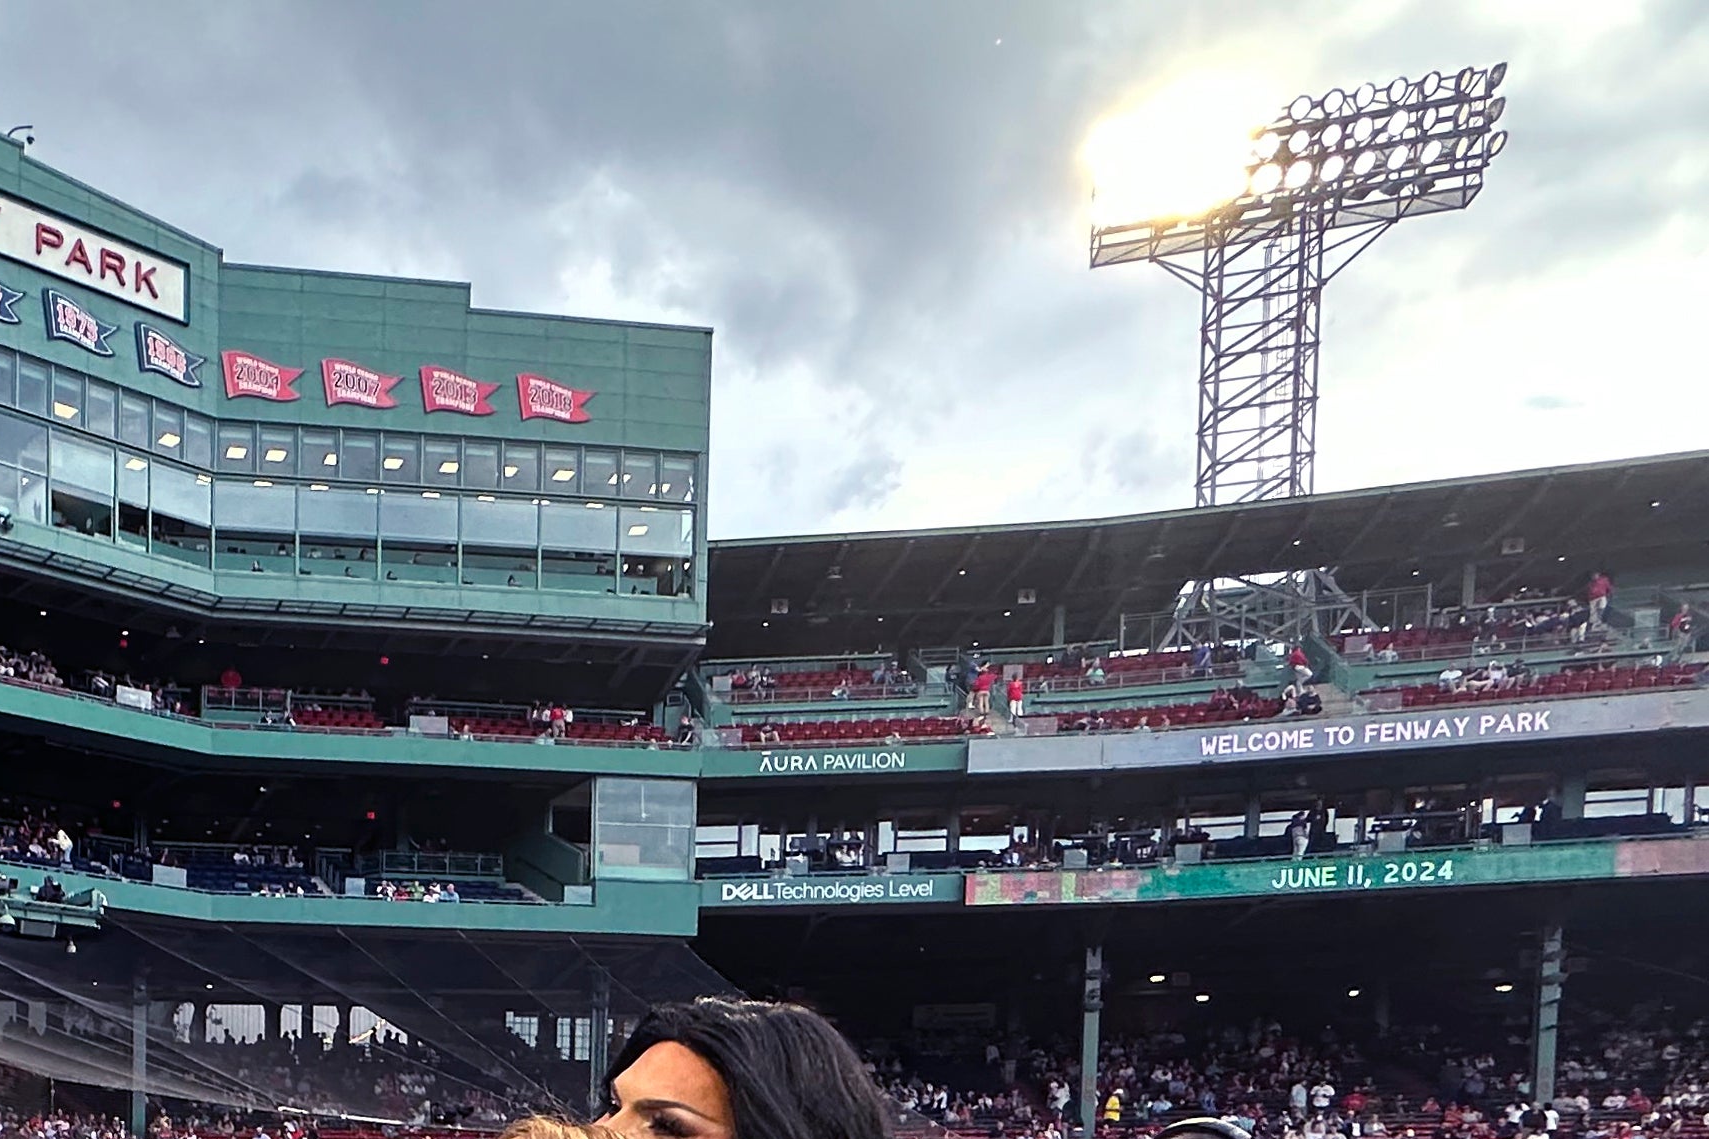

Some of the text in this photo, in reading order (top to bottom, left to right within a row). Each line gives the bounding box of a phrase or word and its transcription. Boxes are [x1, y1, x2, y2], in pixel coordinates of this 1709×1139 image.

[35, 221, 160, 300] PARK
[332, 370, 381, 397] 2007
[431, 377, 478, 405] 2013
[527, 386, 574, 413] 2018
[1200, 710, 1552, 757] WELCOME TO FENWAY PARK
[823, 752, 905, 770] PAVILION
[1271, 860, 1454, 890] JUNE 11, 2024
[721, 879, 934, 903] DELL Technologies Level
